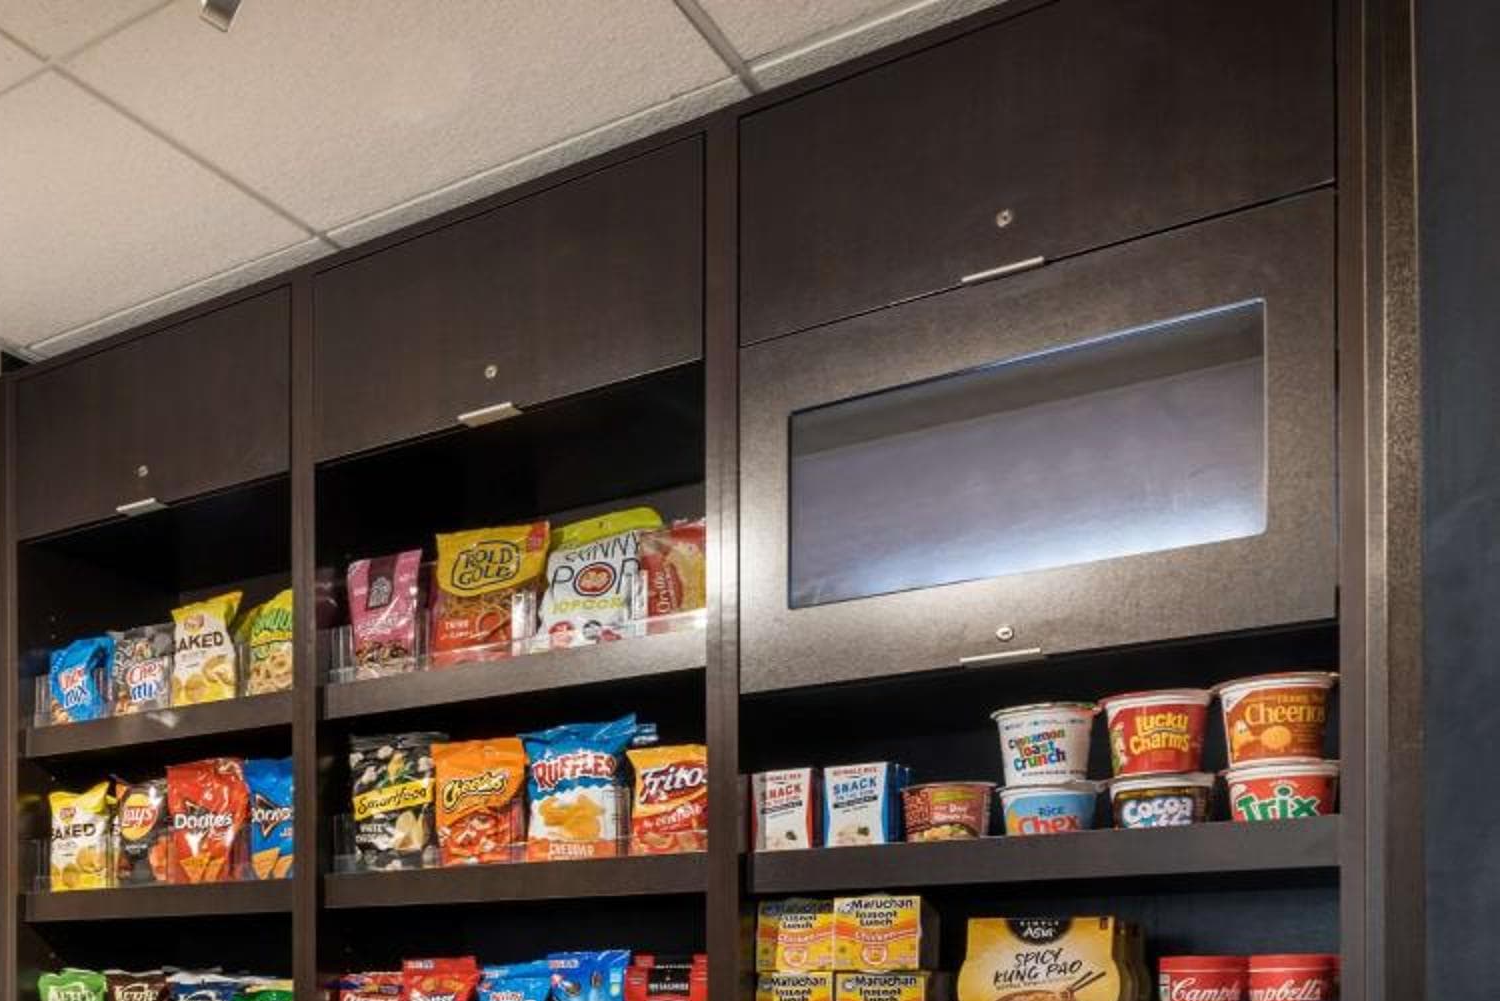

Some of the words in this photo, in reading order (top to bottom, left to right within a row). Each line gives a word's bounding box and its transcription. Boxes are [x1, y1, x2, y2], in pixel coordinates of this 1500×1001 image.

[552, 557, 641, 600] POP
[172, 630, 224, 653] AKED
[1135, 712, 1189, 737] Lucky
[1129, 731, 1190, 755] Charms
[533, 752, 617, 789] RUFFLES
[834, 776, 877, 794] SNACK
[1237, 784, 1319, 822] Trix
[174, 809, 233, 830] Doritos
[1015, 947, 1063, 968] SPICY
[993, 965, 1040, 986] KUNG
[1046, 959, 1083, 978] PAO
